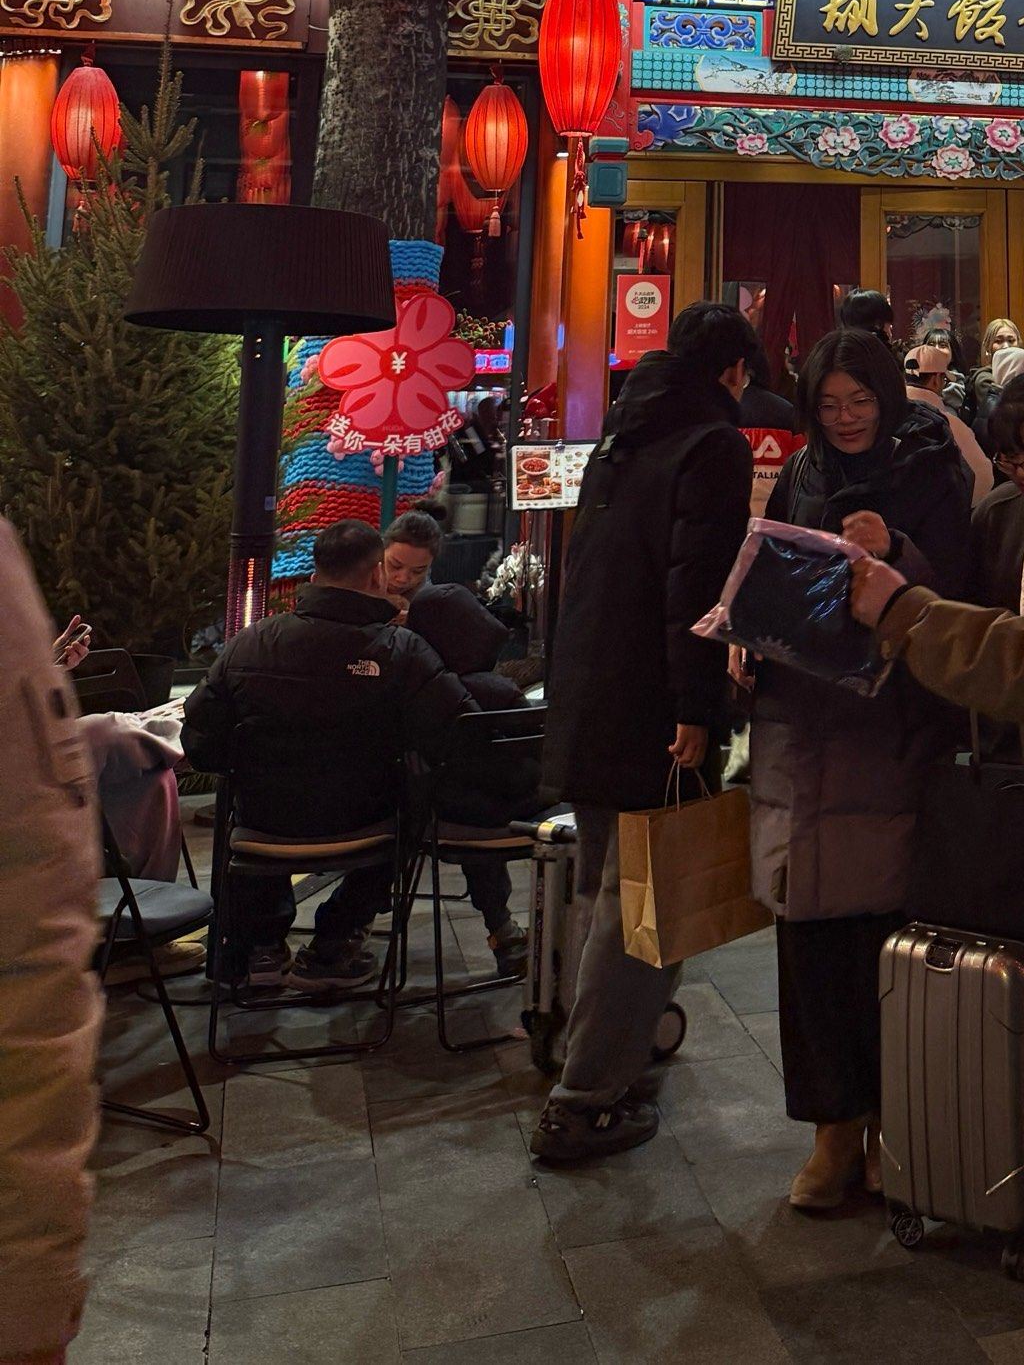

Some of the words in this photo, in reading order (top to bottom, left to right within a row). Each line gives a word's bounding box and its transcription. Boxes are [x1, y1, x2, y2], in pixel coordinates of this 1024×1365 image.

[327, 410, 462, 453] 送你一朵有钳花
[753, 471, 780, 479] TALIA
